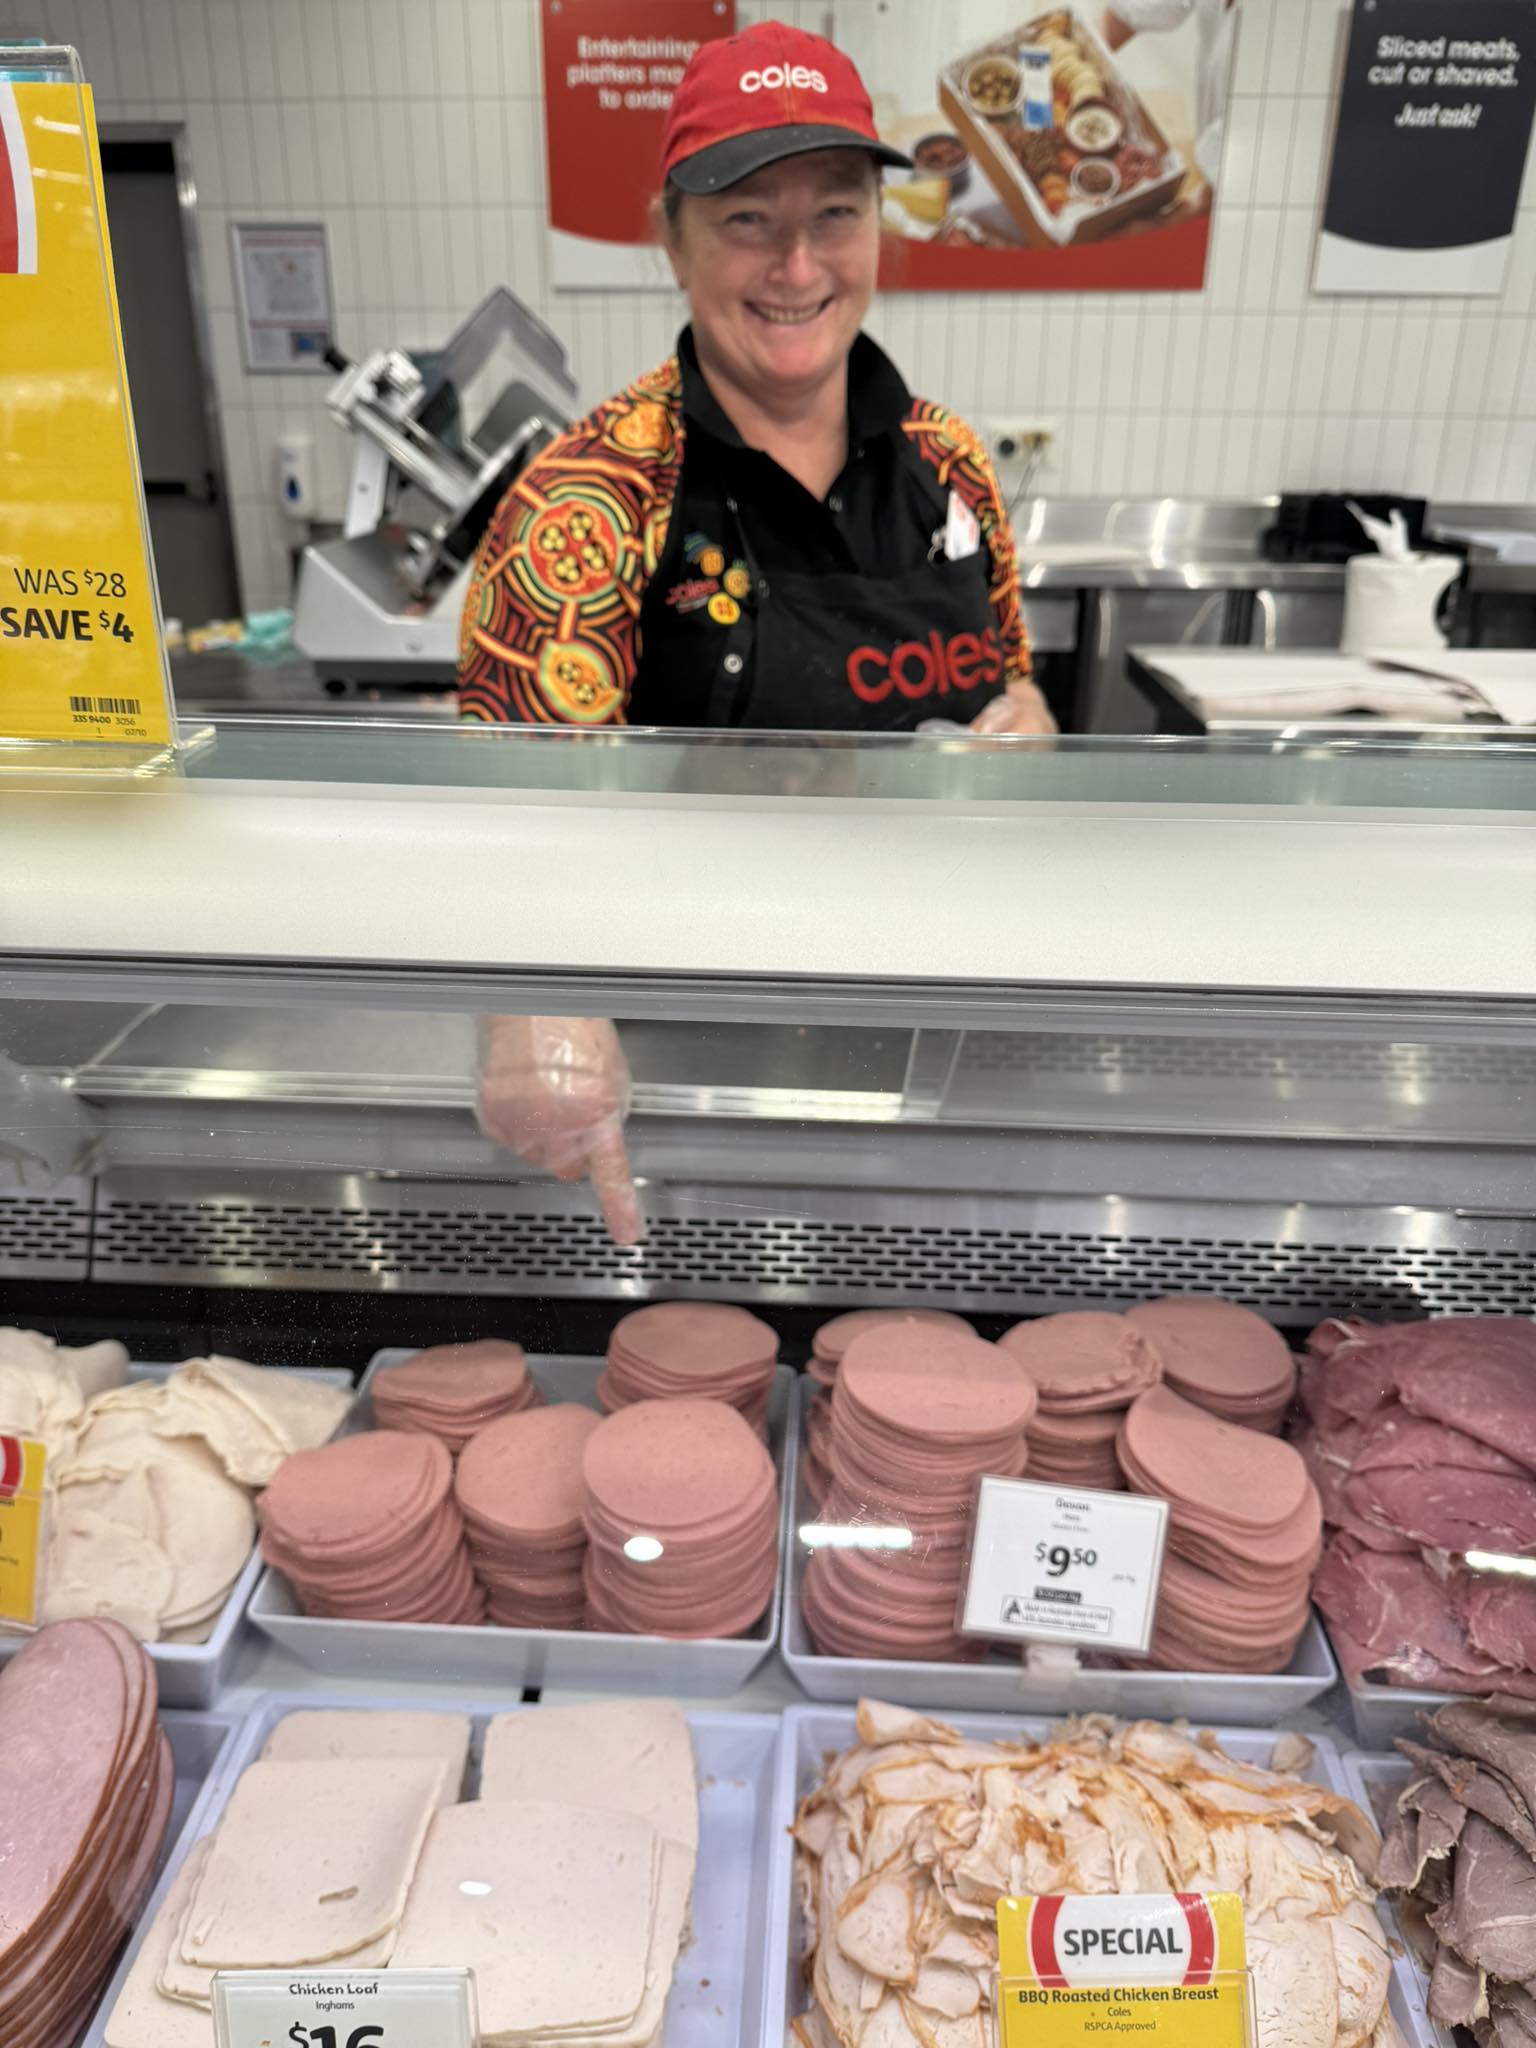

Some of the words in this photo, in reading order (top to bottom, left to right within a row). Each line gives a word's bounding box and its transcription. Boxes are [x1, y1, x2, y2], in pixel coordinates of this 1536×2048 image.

[1377, 35, 1447, 59] Sliced
[1447, 37, 1520, 62] meats,
[567, 63, 646, 87] platters
[648, 65, 687, 84] ma
[739, 61, 829, 93] coles
[1368, 62, 1406, 85] cut
[1407, 66, 1433, 84] or
[1434, 63, 1518, 86] shaved.
[598, 86, 622, 109] to
[623, 87, 674, 109] orde
[1394, 102, 1440, 128] Just
[14, 567, 78, 596] WAS
[83, 569, 126, 598] $28
[0, 606, 93, 641] SAVE
[99, 610, 134, 643] $4
[847, 630, 1001, 703] coles
[1063, 1927, 1183, 1956] SPECIAL
[289, 1983, 344, 1995] Chicken
[347, 1982, 379, 1995] Loaf
[1018, 1989, 1048, 2004] BBQ
[1052, 1988, 1110, 2003] Roasted
[1113, 1988, 1169, 2001] Chicken
[1172, 1987, 1219, 2000] Breast
[316, 2000, 355, 2012] Inghams
[1107, 2006, 1132, 2017] Coles
[1084, 2021, 1112, 2031] RSPCA
[1115, 2020, 1156, 2032] Approved
